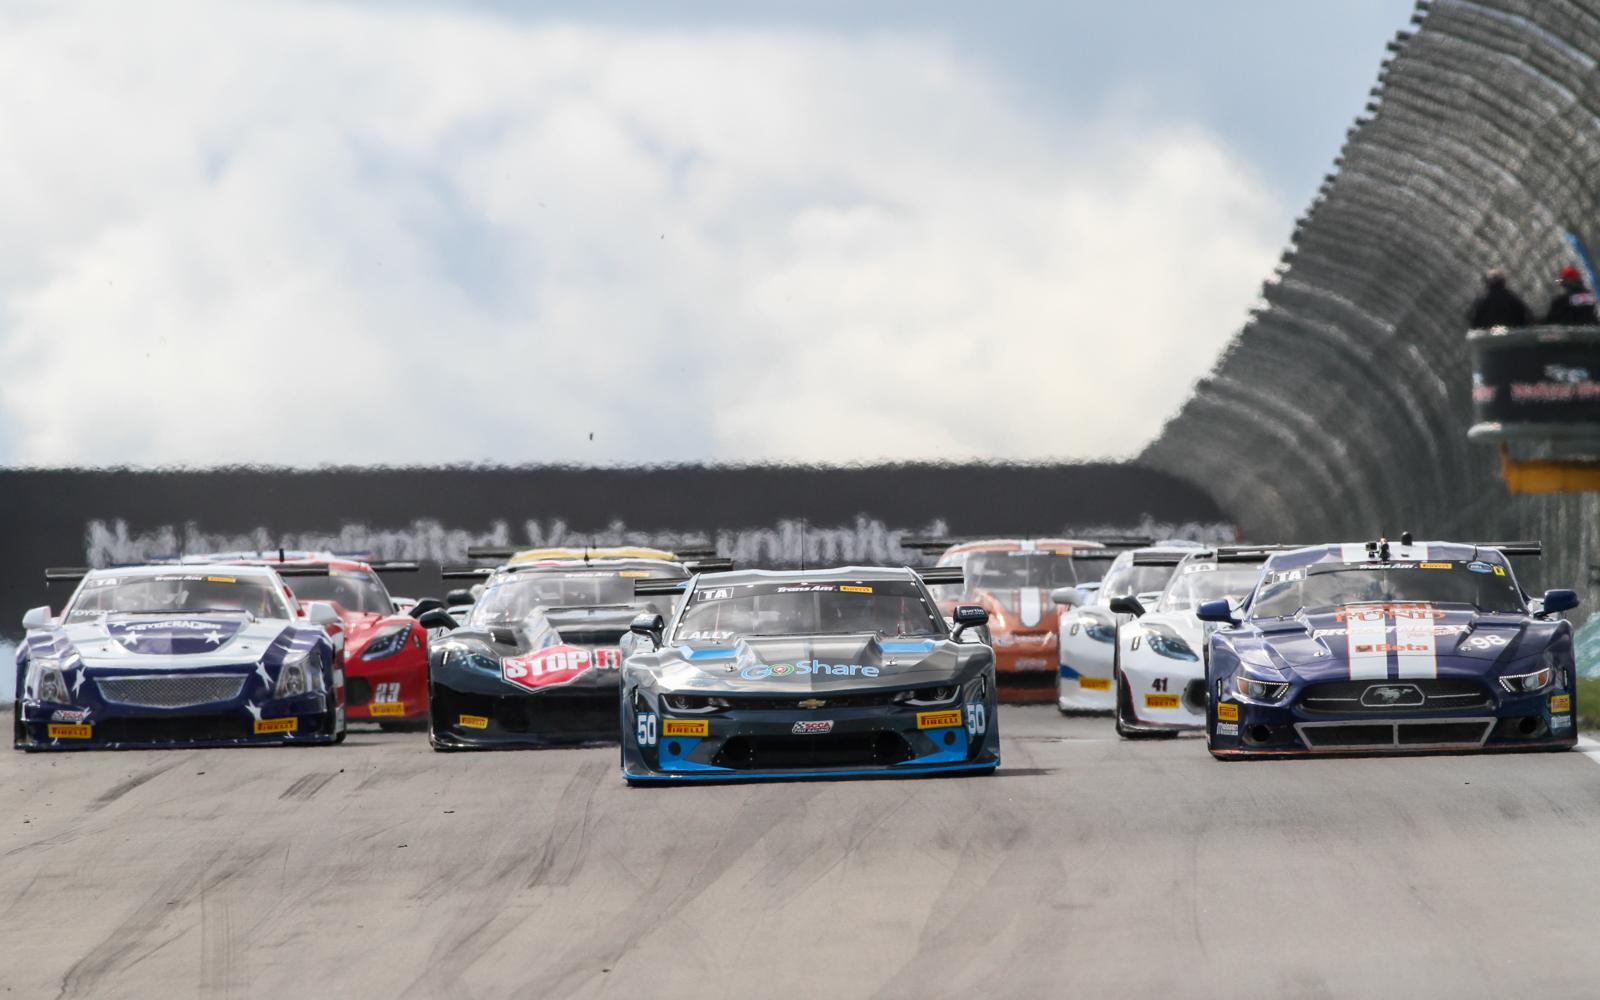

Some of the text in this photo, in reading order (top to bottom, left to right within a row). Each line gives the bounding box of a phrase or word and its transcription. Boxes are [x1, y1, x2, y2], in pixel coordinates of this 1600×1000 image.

[1277, 570, 1301, 581] TA
[704, 588, 728, 600] TA
[841, 585, 871, 593] PIRELLI
[678, 631, 735, 640] LALLY
[1470, 634, 1506, 649] 98
[1376, 643, 1428, 652] Beta
[505, 651, 590, 679] STOP
[1152, 677, 1168, 692] 41
[375, 682, 400, 704] 23
[258, 719, 294, 731] PIRELLI
[921, 713, 958, 726] PIRELLI
[966, 703, 985, 735] 50
[51, 726, 88, 736] PIRELLI
[637, 714, 657, 745] 50
[667, 722, 705, 733] PIRELLI
